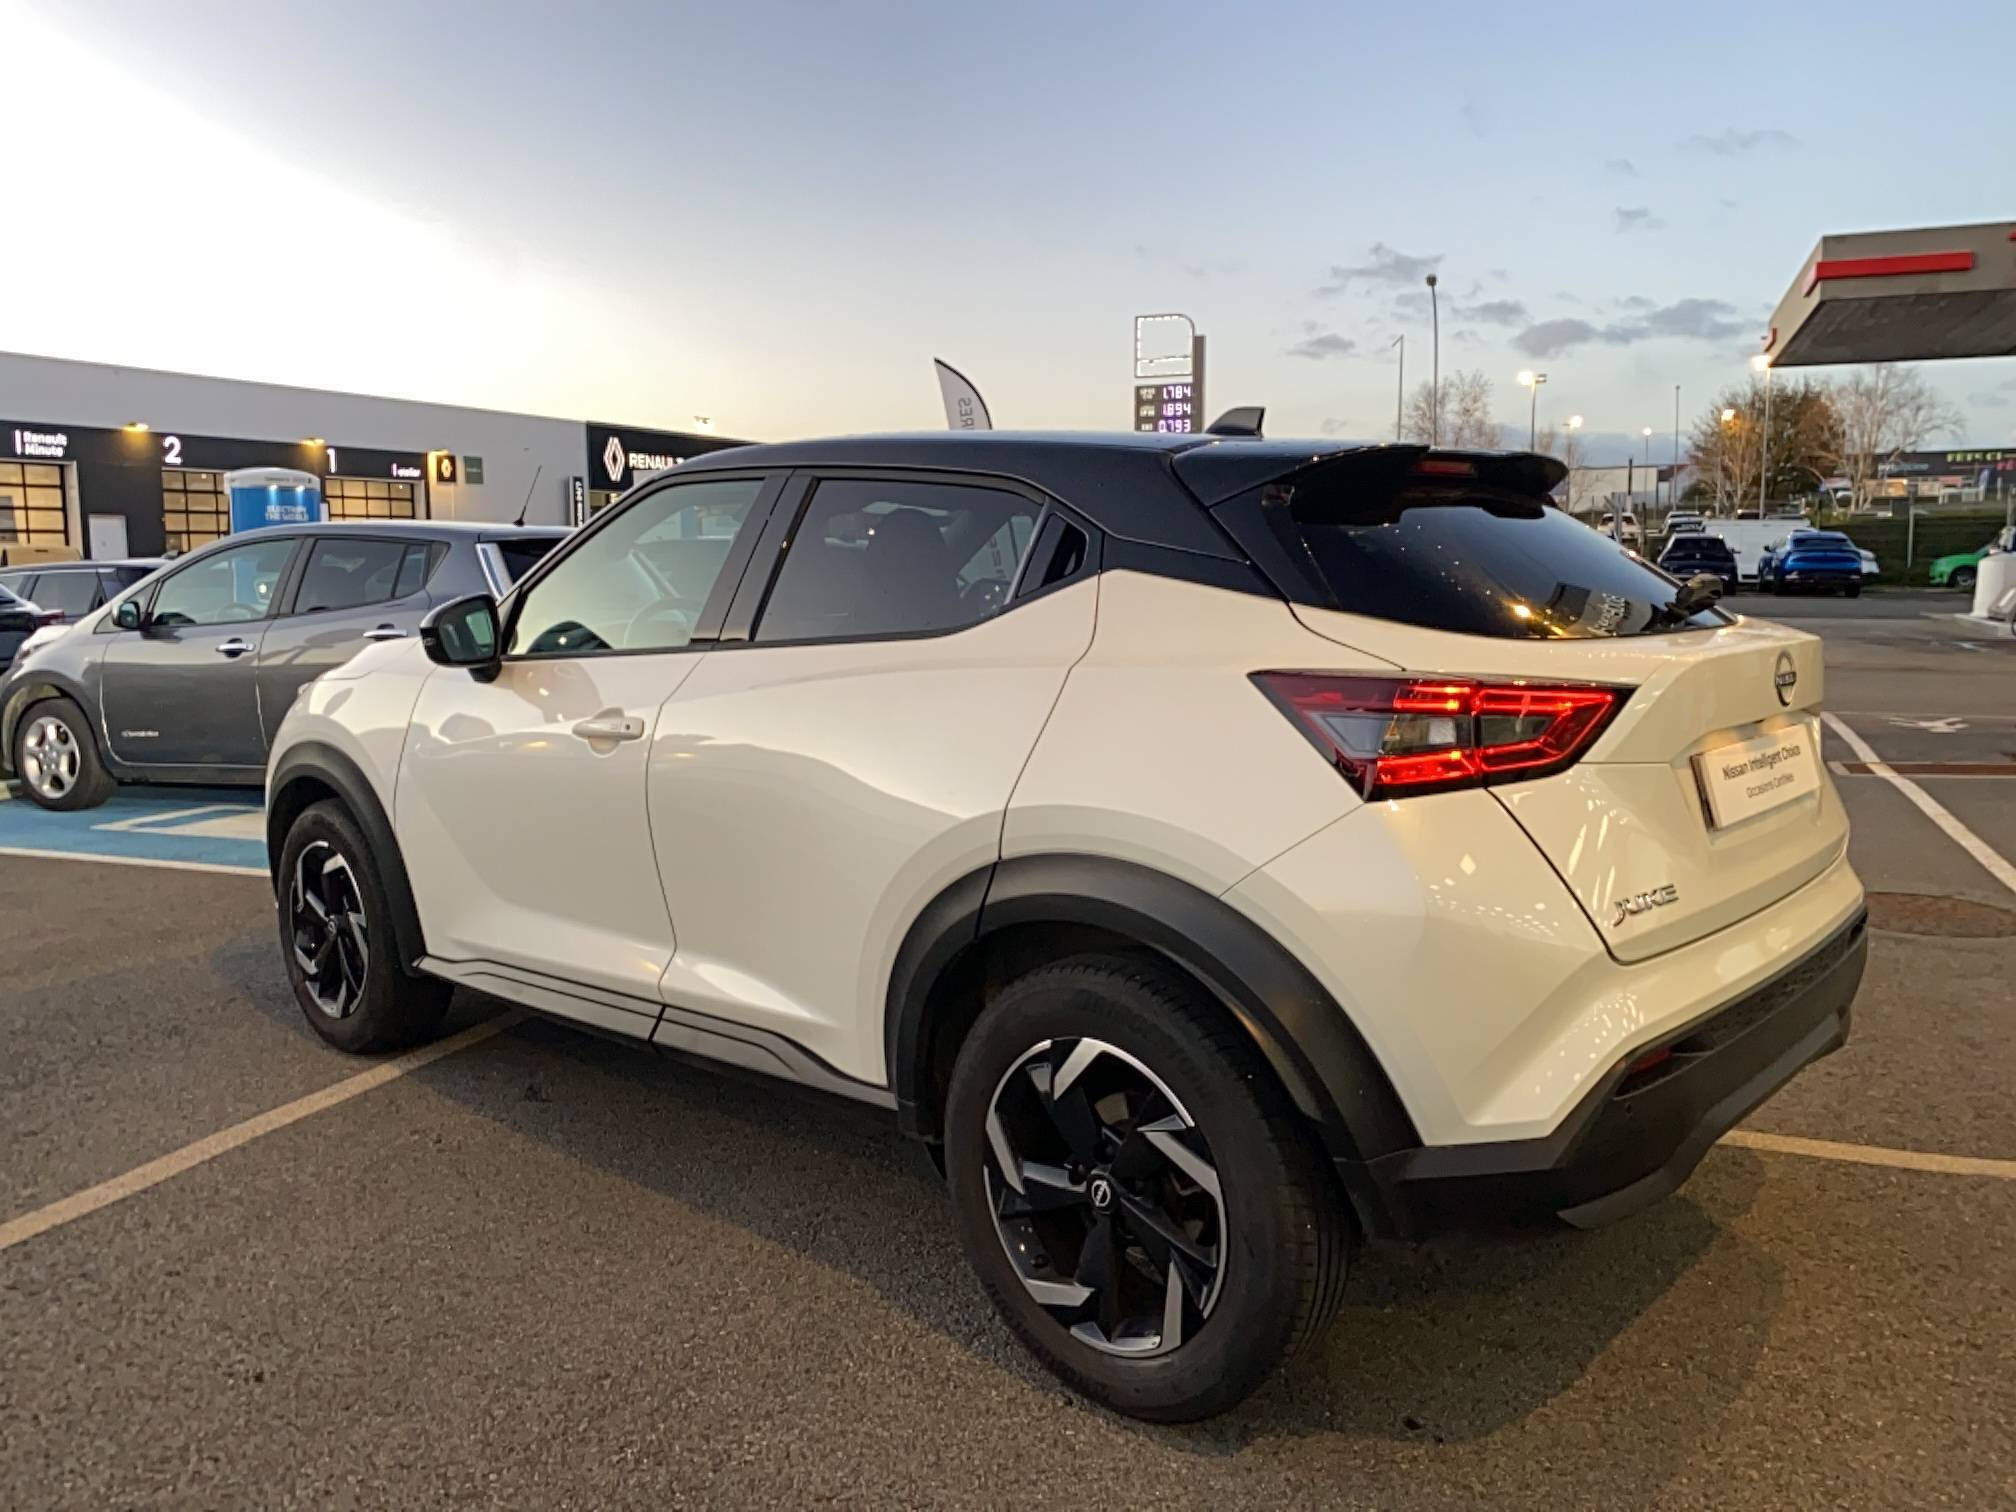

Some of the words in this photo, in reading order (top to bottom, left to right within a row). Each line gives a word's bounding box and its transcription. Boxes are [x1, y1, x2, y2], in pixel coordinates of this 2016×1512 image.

[162, 435, 183, 465] 2
[326, 448, 337, 473] 1
[1722, 764, 1749, 780] Nissan
[1748, 751, 1782, 771] Intelligent
[1613, 883, 1679, 928] JUKE
